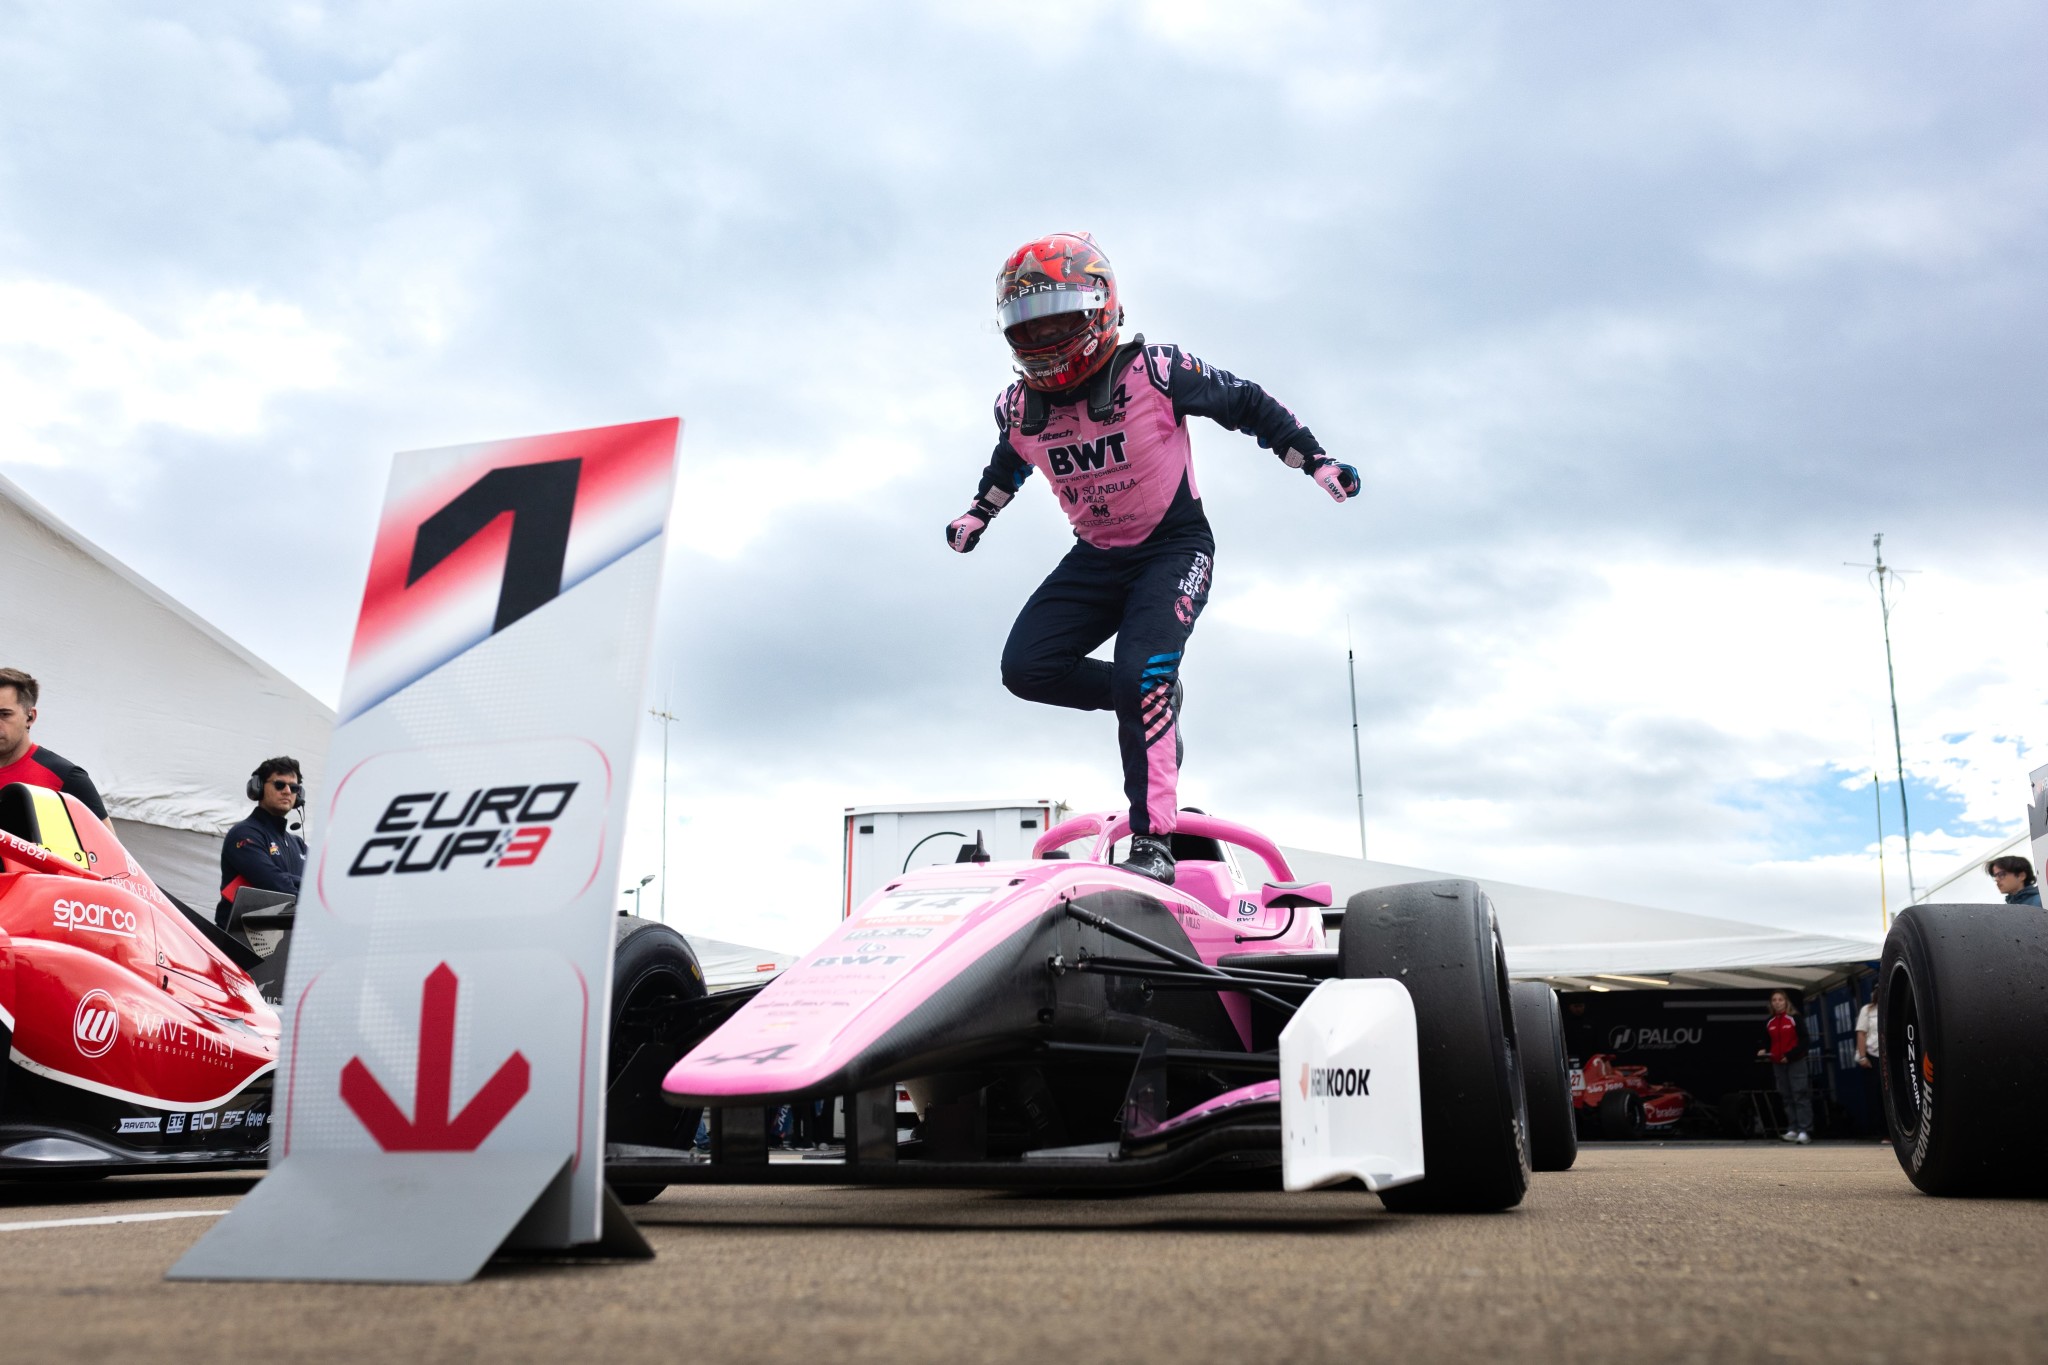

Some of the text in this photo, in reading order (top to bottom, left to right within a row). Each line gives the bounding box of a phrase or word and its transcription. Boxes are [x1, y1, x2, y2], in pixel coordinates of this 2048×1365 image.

[1002, 283, 1067, 307] ALPINE
[1084, 341, 1097, 354] BELL
[1038, 429, 1074, 442] Hitech
[1047, 431, 1127, 477] BWT
[1070, 474, 1090, 483] WATER
[1328, 482, 1344, 499] BWT
[957, 524, 967, 540] BWT
[405, 457, 583, 635] 1
[1183, 551, 1205, 595] CHANGE
[375, 782, 580, 834] EURO
[10, 838, 48, 862] EGOZI
[894, 897, 965, 911] 14
[53, 899, 137, 932] sparco
[1186, 916, 1201, 930] MILLS
[808, 956, 906, 969] BWT
[134, 1011, 235, 1059] WAVE ITALY
[1638, 1028, 1703, 1044] PALOU
[132, 1040, 234, 1071] IMMERSIVE RACING
[1571, 1074, 1581, 1087] 27
[123, 1120, 159, 1130] RAVENOL
[169, 1115, 185, 1128] ETS
